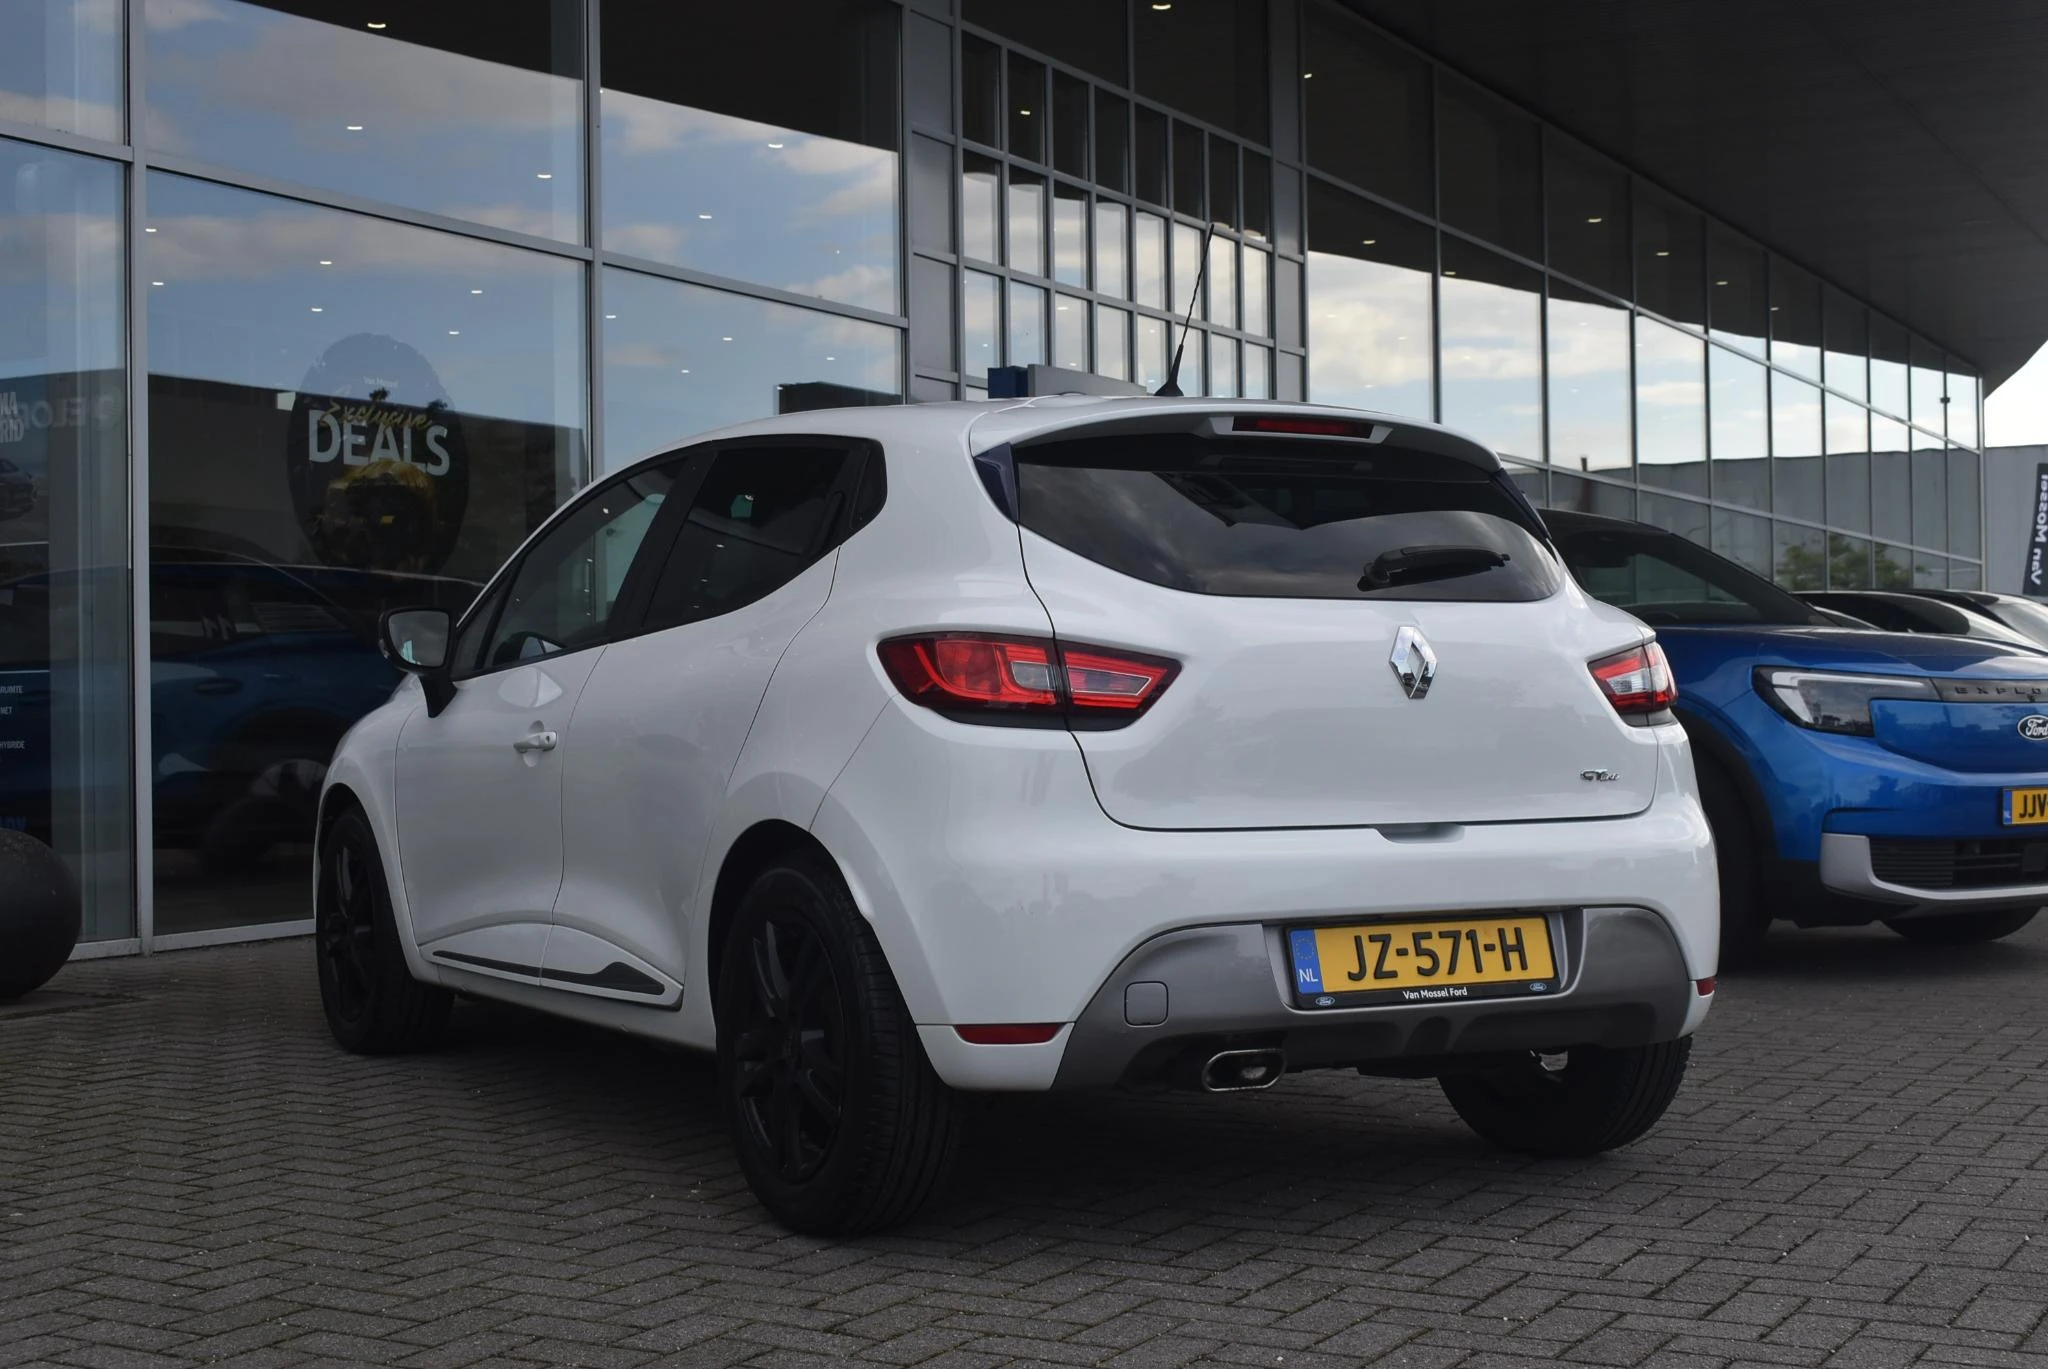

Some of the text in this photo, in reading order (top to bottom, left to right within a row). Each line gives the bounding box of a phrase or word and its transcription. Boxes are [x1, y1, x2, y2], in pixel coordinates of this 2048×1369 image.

[308, 409, 451, 477] DEALS
[1347, 926, 1529, 982] JZ-571-H
[1298, 968, 1319, 984] NL
[1402, 986, 1468, 1000] Van Mossel Ford
